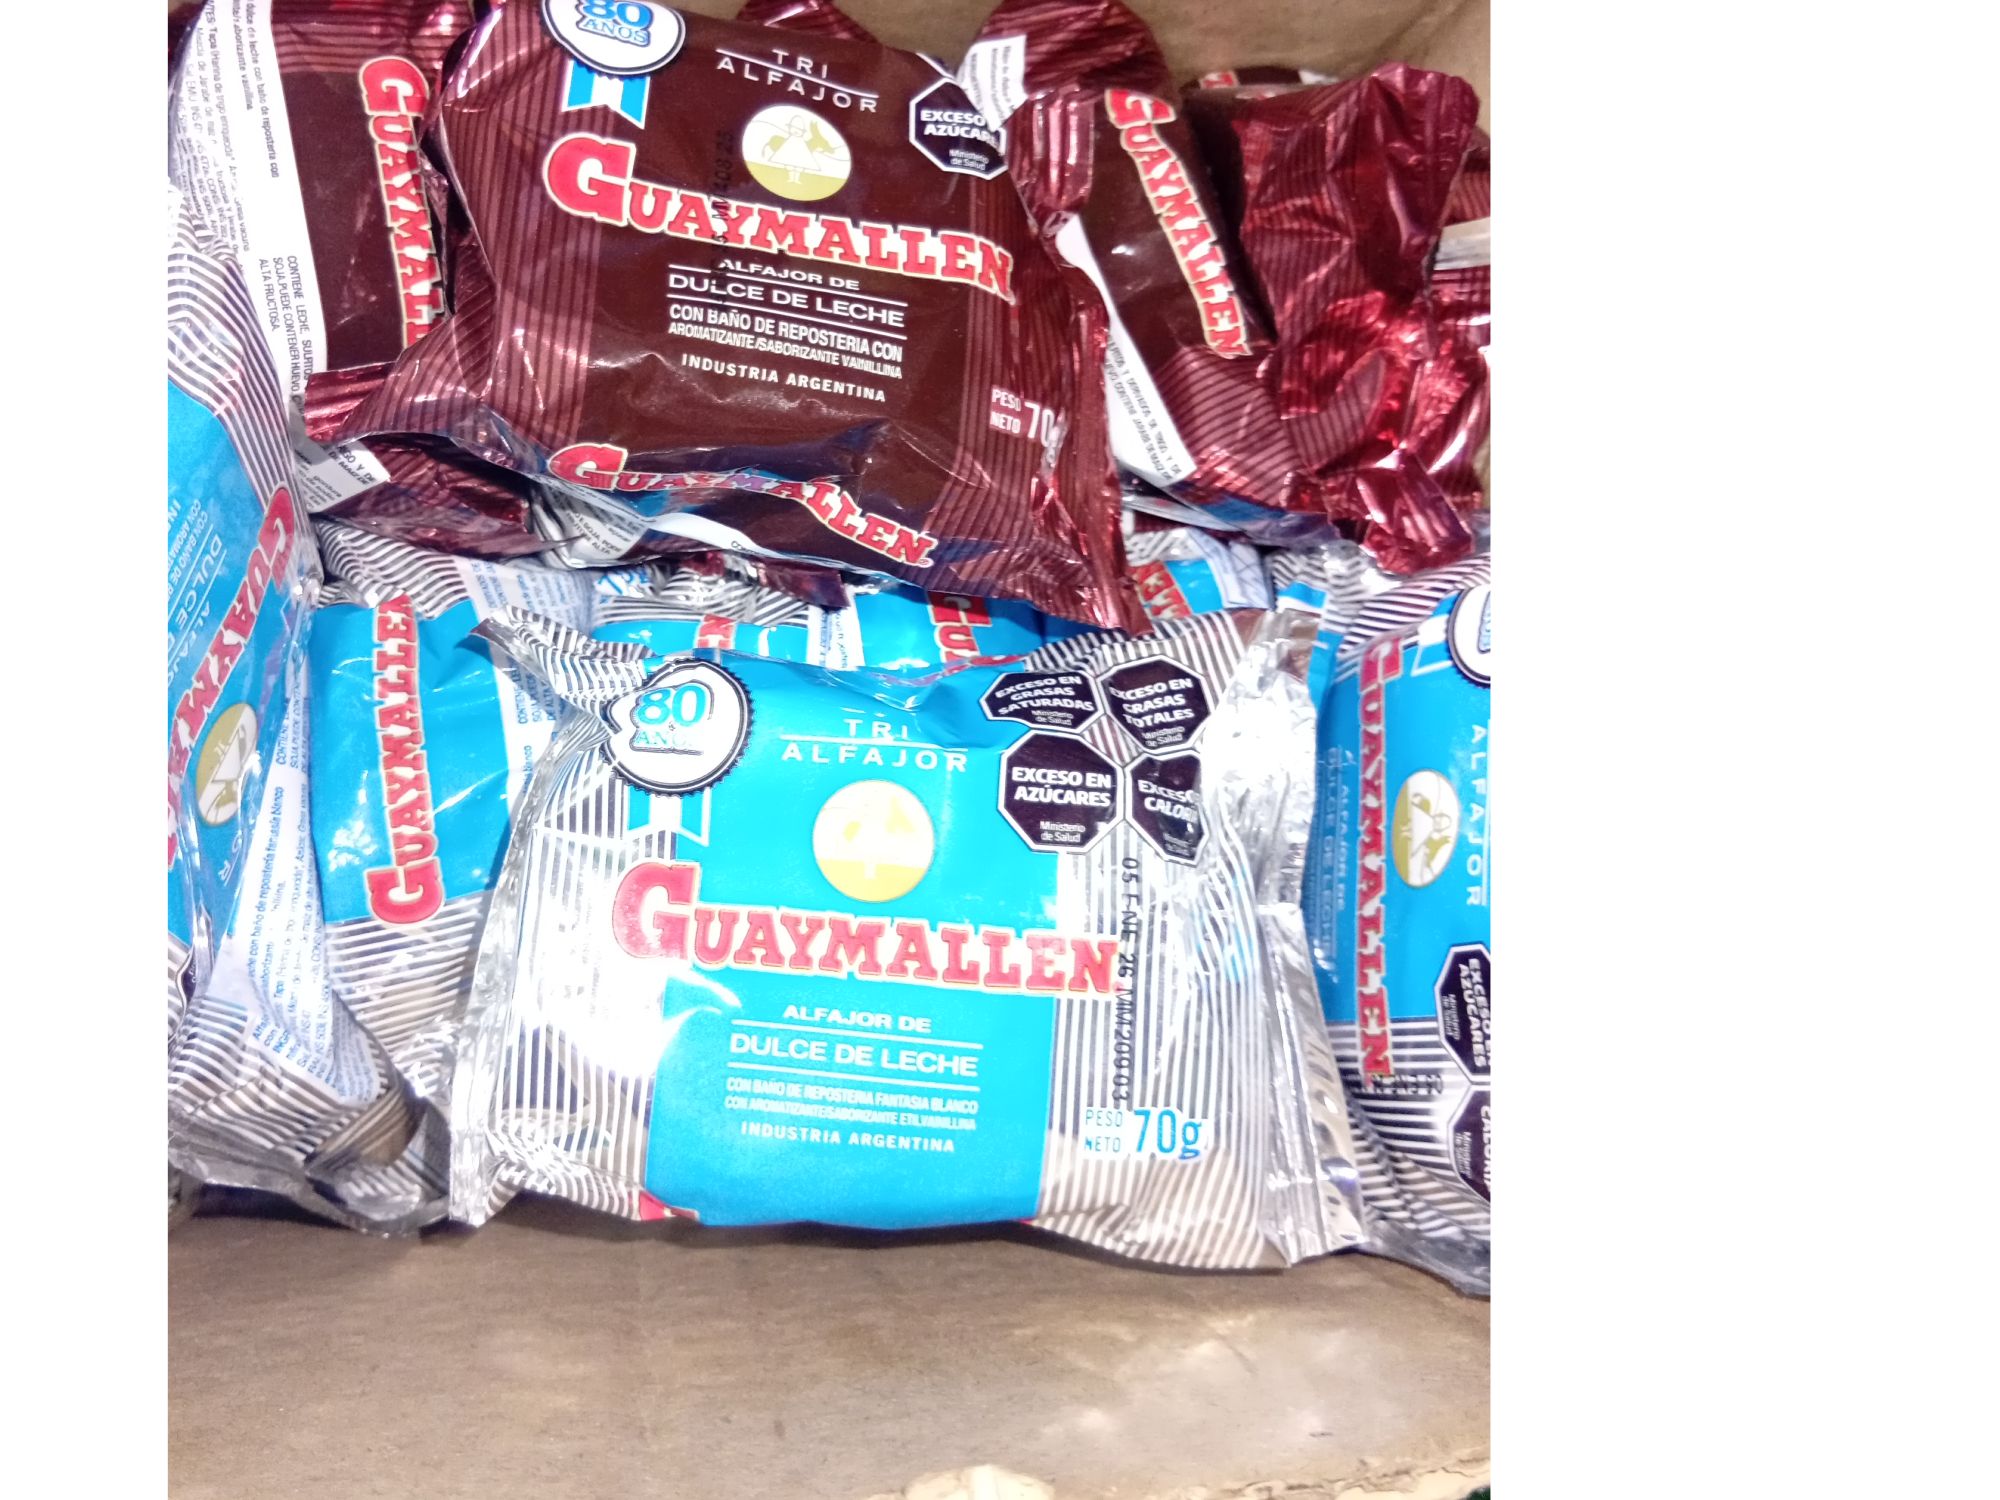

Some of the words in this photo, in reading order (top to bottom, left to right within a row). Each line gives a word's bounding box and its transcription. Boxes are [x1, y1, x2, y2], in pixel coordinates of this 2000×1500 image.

[583, 0, 652, 27] 80
[771, 49, 829, 79] TRI
[716, 56, 879, 113] ALFAJOR
[920, 110, 986, 126] EXCESO
[543, 131, 1018, 304] GUAYMALLEN
[259, 258, 272, 282] ALTA
[287, 255, 304, 299] CONTIENE
[718, 259, 823, 285] ALFAJOR
[829, 277, 860, 291] DE
[669, 274, 764, 301] DULCE
[772, 288, 809, 309] DE
[816, 297, 905, 328] LECHE
[669, 304, 703, 322] CON
[707, 307, 751, 331] BAÑO
[754, 316, 775, 336] DE
[872, 343, 903, 363] CON
[681, 354, 779, 383] INDUSTRIA
[786, 373, 886, 403] ARGENTINA
[991, 388, 1021, 412] PESO
[990, 411, 1021, 434] NETO
[547, 442, 938, 567] GUAYMALLEN
[175, 533, 223, 630] DULCE
[995, 678, 1057, 698] EXCESO
[1058, 676, 1082, 686] EN
[1010, 686, 1075, 701] GRASAS
[1169, 678, 1193, 691] EN
[637, 685, 707, 727] 80
[998, 697, 1095, 715] SATURADAS
[1123, 694, 1186, 714] GRASAS
[845, 718, 909, 738] TRI
[1124, 709, 1194, 728] TOTALES
[781, 742, 968, 772] ALFAJOR
[1011, 767, 1083, 786] EXCESO
[1086, 772, 1111, 789] EN
[1014, 783, 1111, 808] AZÚCARES
[1039, 821, 1086, 834] Ministerio
[1466, 724, 1488, 907] ALFAJOR
[1041, 830, 1054, 842] de
[1055, 831, 1081, 843] Salud
[612, 862, 1120, 997] GUAYMALLEN
[1117, 953, 1136, 978] 26
[1469, 958, 1491, 1033] EXCESO
[783, 1004, 892, 1029] ALFAJOR
[898, 1016, 932, 1033] DE
[730, 1033, 828, 1061] DULCE
[835, 1043, 874, 1066] DE
[881, 1049, 979, 1077] LECHE
[725, 1095, 749, 1110] CON
[727, 1077, 751, 1093] CON
[787, 1082, 803, 1098] DE
[930, 1097, 979, 1115] BLANCO
[1085, 1109, 1123, 1128] PESO
[741, 1121, 841, 1145] INDUSTRIA
[848, 1132, 955, 1153] ARGENTINA
[1085, 1136, 1121, 1152] NETO
[1133, 1109, 1203, 1160] 70g
